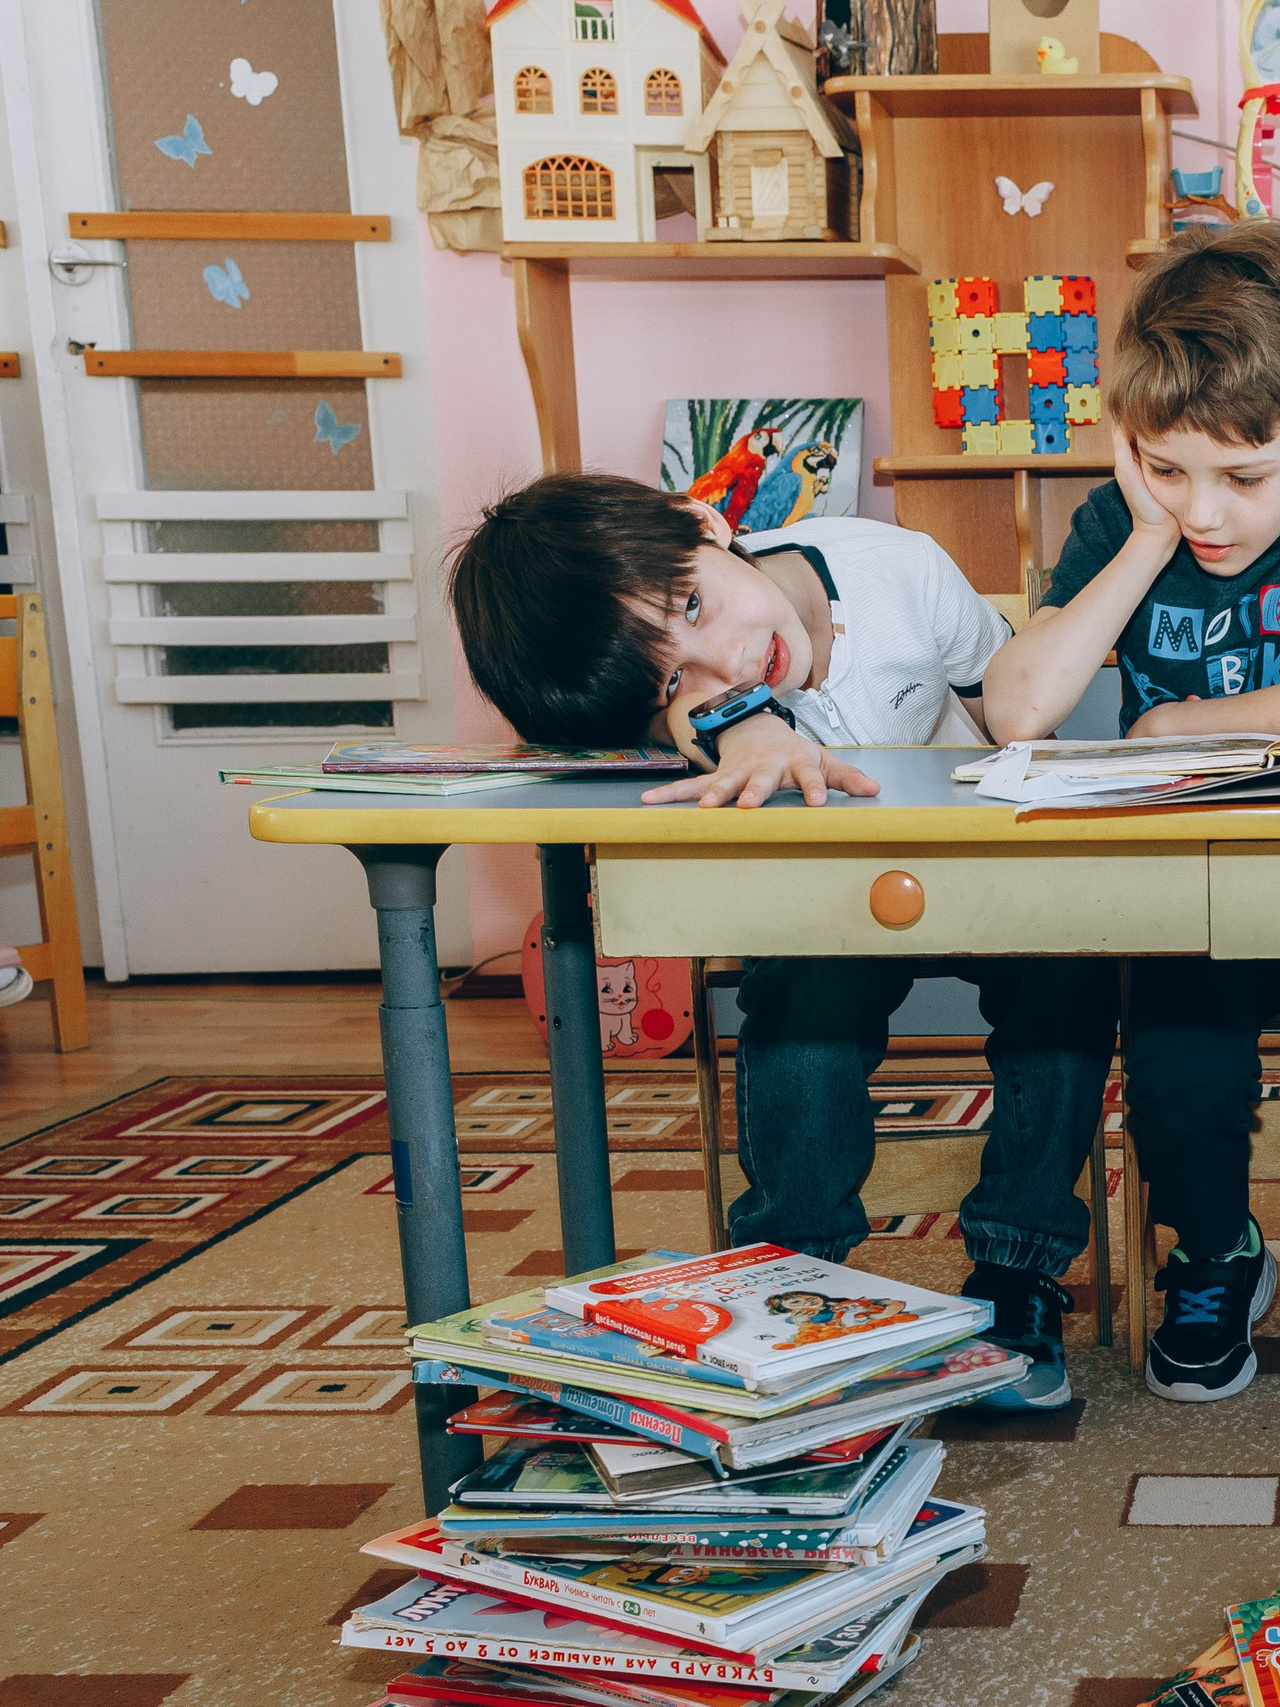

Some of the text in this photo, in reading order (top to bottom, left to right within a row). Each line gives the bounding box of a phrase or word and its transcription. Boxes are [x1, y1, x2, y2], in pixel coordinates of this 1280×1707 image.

[566, 1387, 625, 1426] Потешки
[629, 1410, 683, 1445] Песенки
[563, 1583, 590, 1600] Учимся
[591, 1591, 616, 1607] читать
[642, 1606, 657, 1618] лет
[426, 1639, 434, 1652] 5
[478, 1644, 488, 1657] 2
[671, 1661, 774, 1683] БУКВАРЬ
